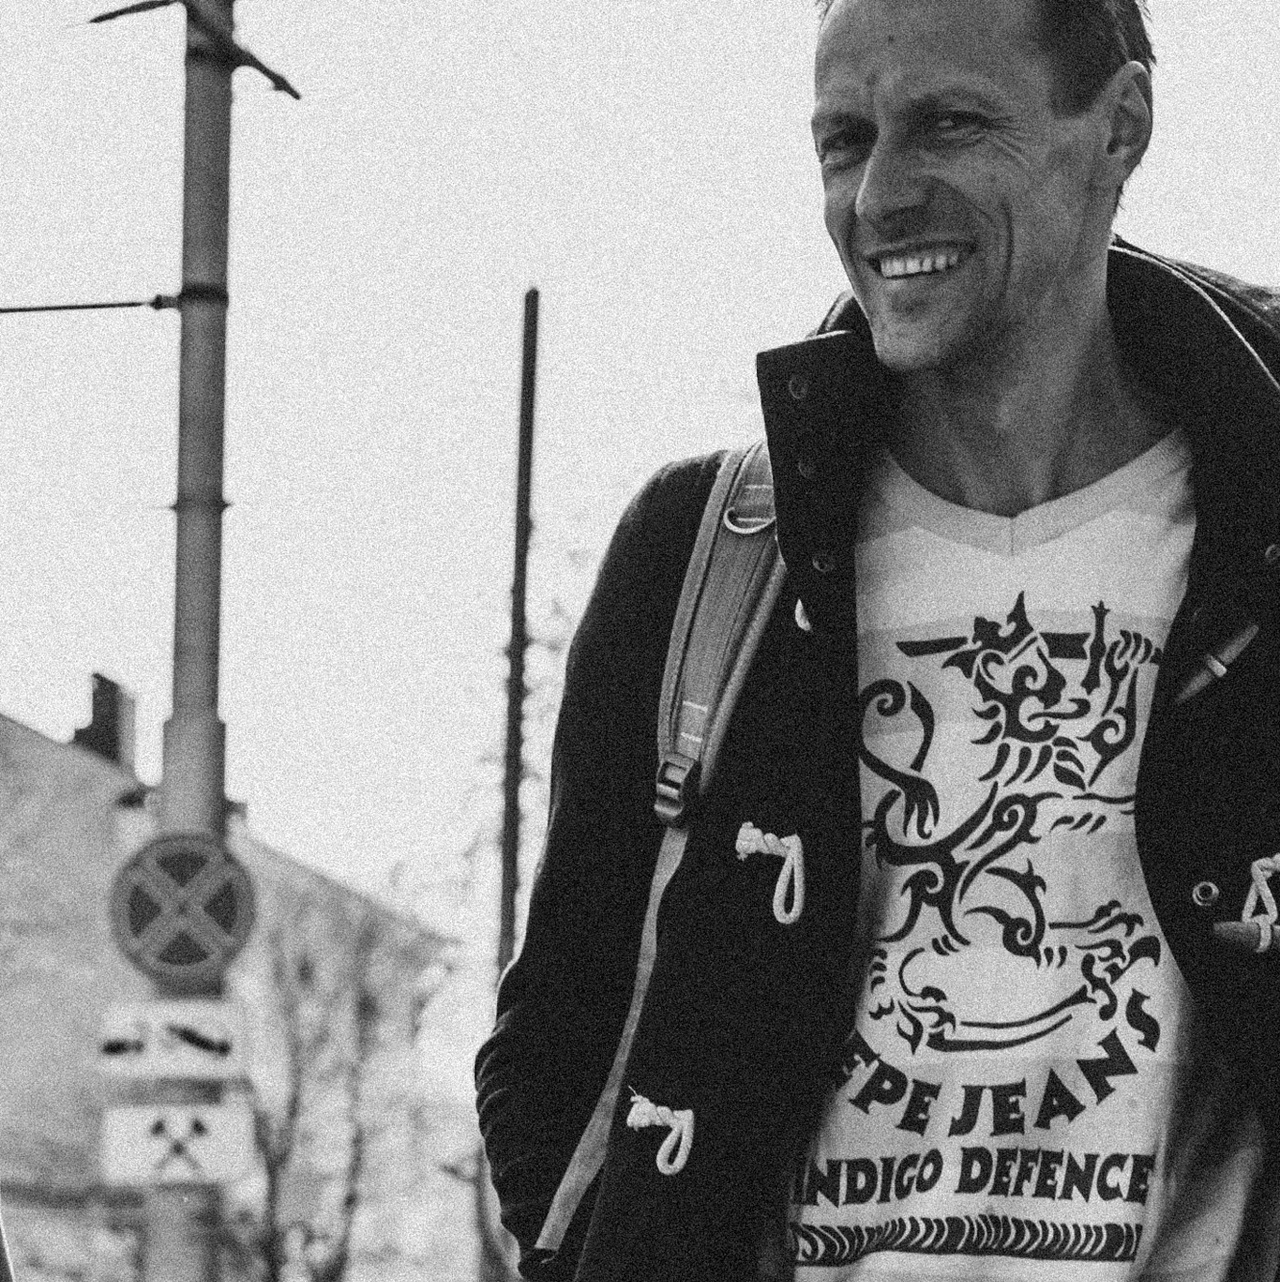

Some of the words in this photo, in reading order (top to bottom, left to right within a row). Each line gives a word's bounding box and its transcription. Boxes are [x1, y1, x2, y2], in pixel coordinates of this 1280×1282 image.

[832, 1030, 942, 1136] EPE
[948, 988, 1161, 1137] JEANS
[954, 1146, 1156, 1206] DEFENCE
